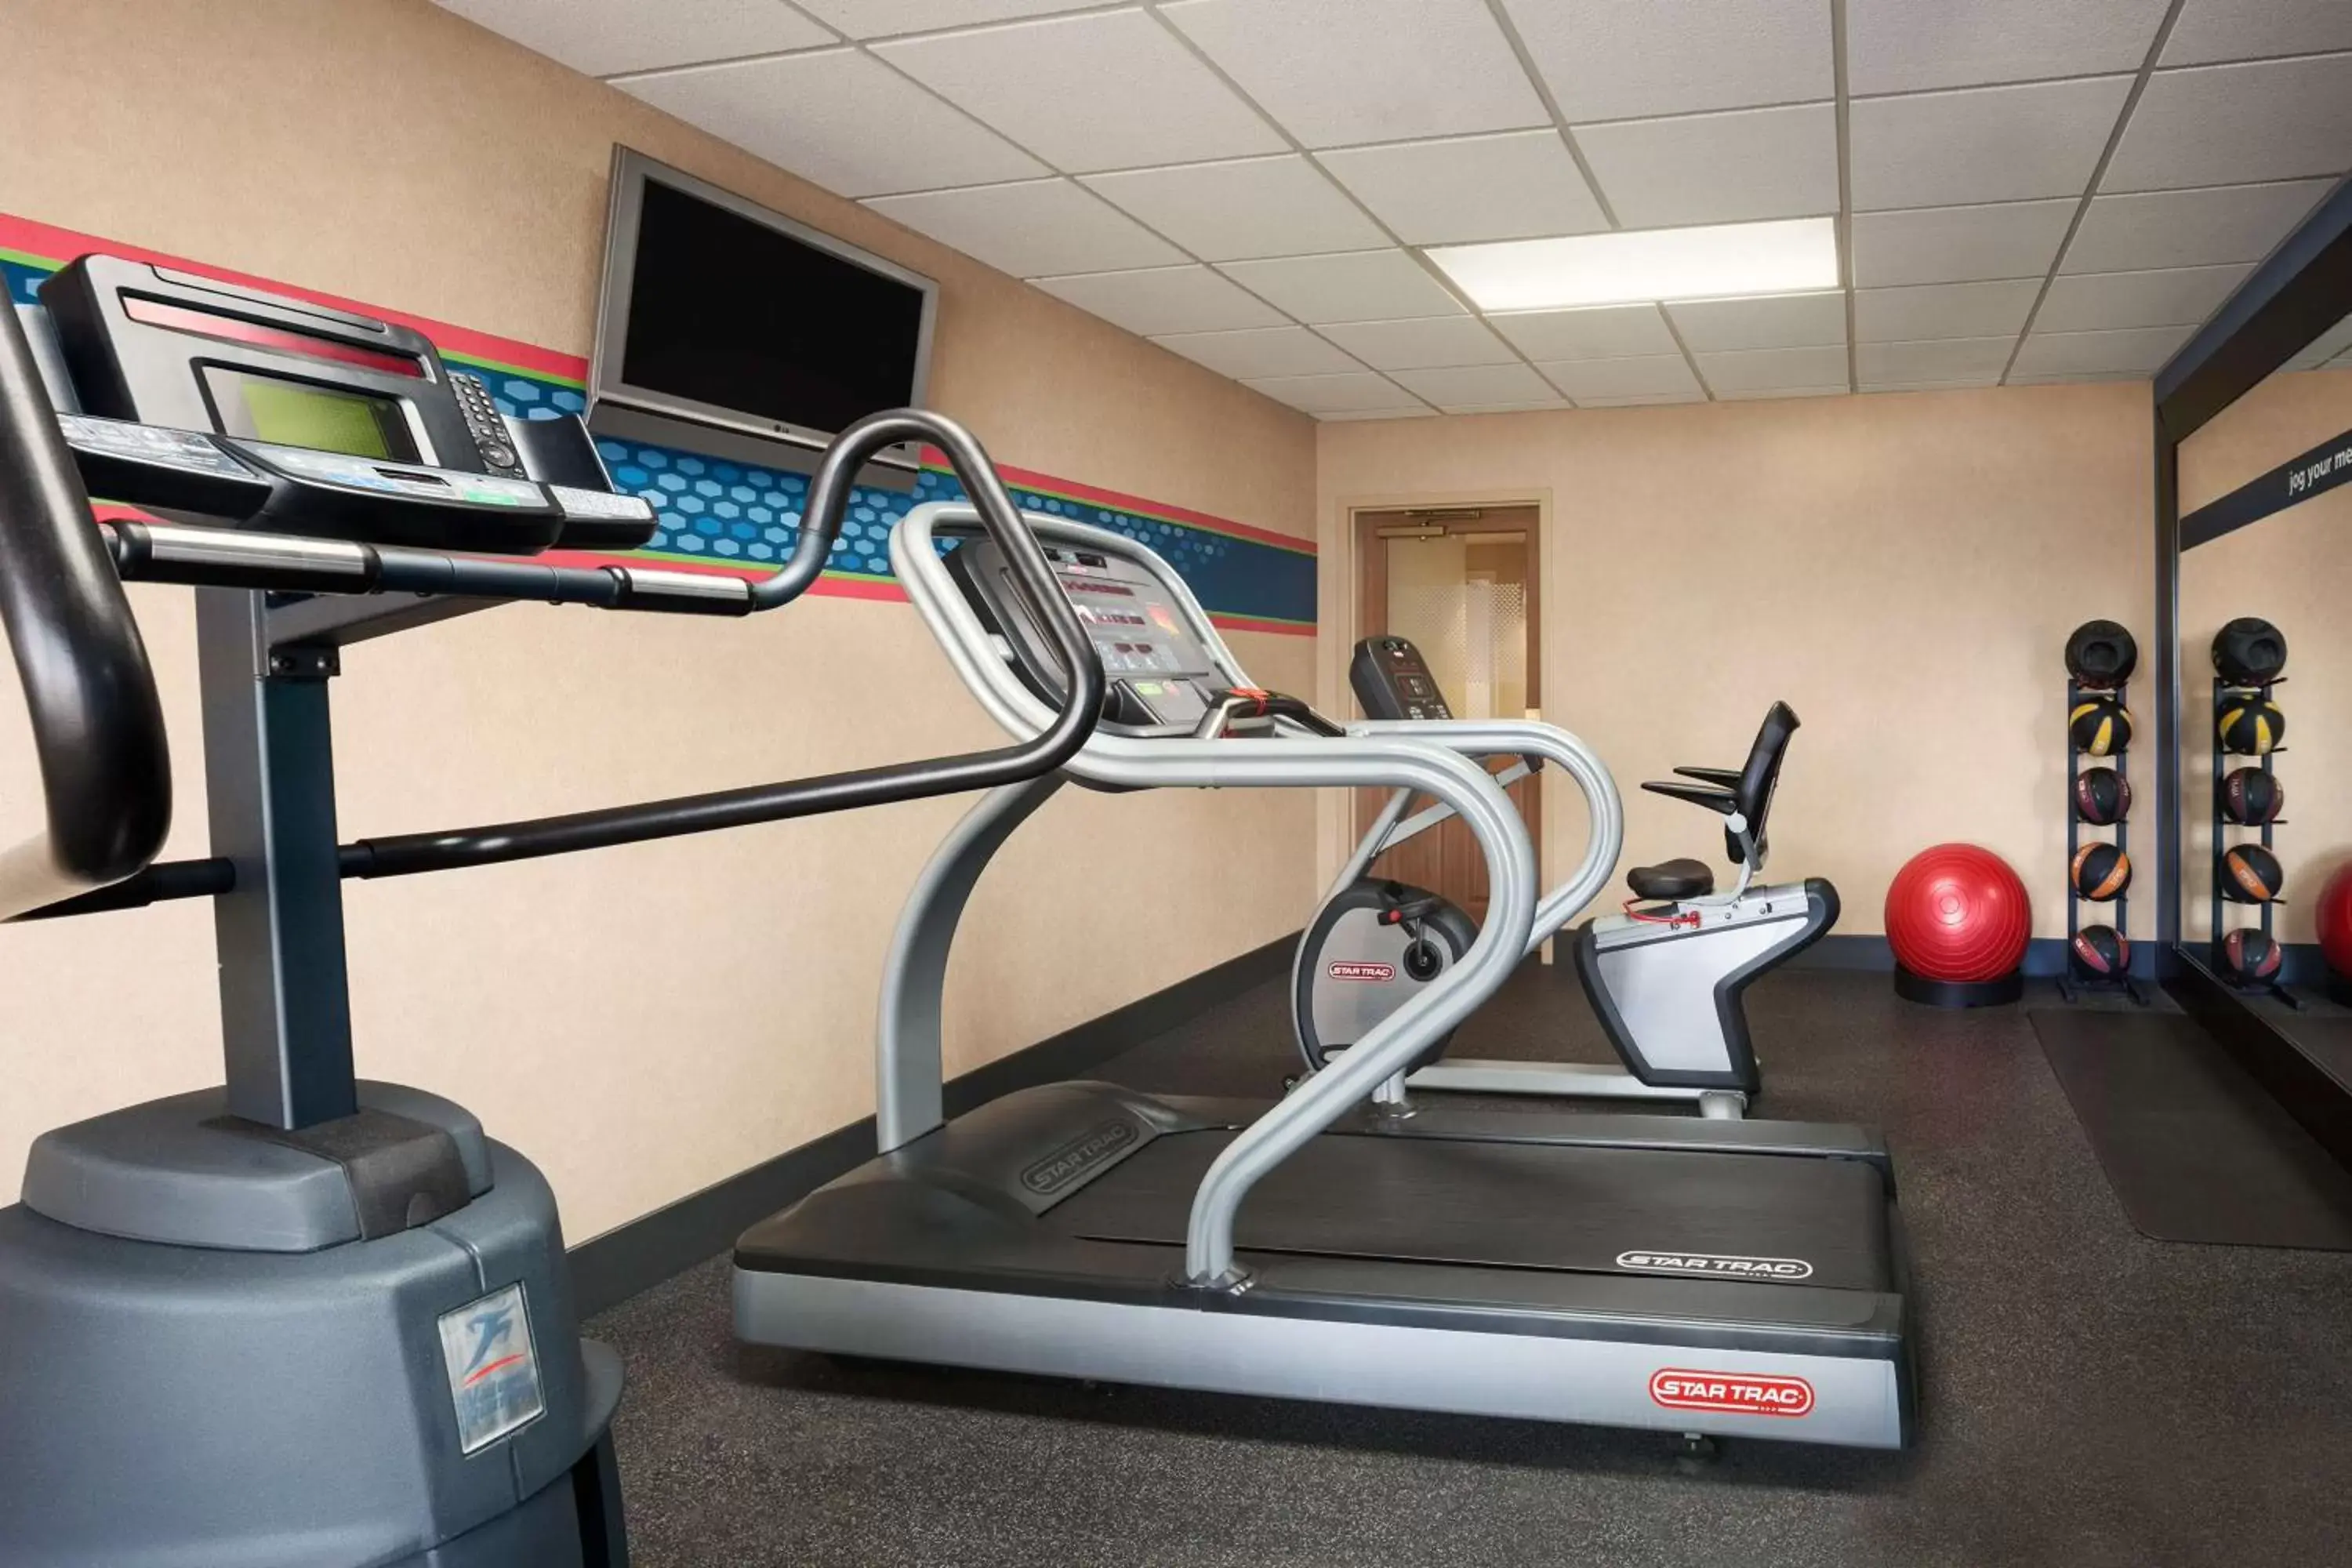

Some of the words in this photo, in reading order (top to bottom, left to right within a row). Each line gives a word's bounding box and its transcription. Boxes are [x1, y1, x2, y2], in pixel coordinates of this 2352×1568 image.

[2289, 470, 2306, 496] jog
[2307, 457, 2332, 488] your
[1034, 1152, 1082, 1188] STAR
[1079, 1123, 1126, 1156] TRAC
[1628, 1255, 1708, 1268] STAR
[1713, 1260, 1798, 1273] TRAC
[1663, 1381, 1726, 1399] STAR
[1730, 1385, 1798, 1404] TRAC
